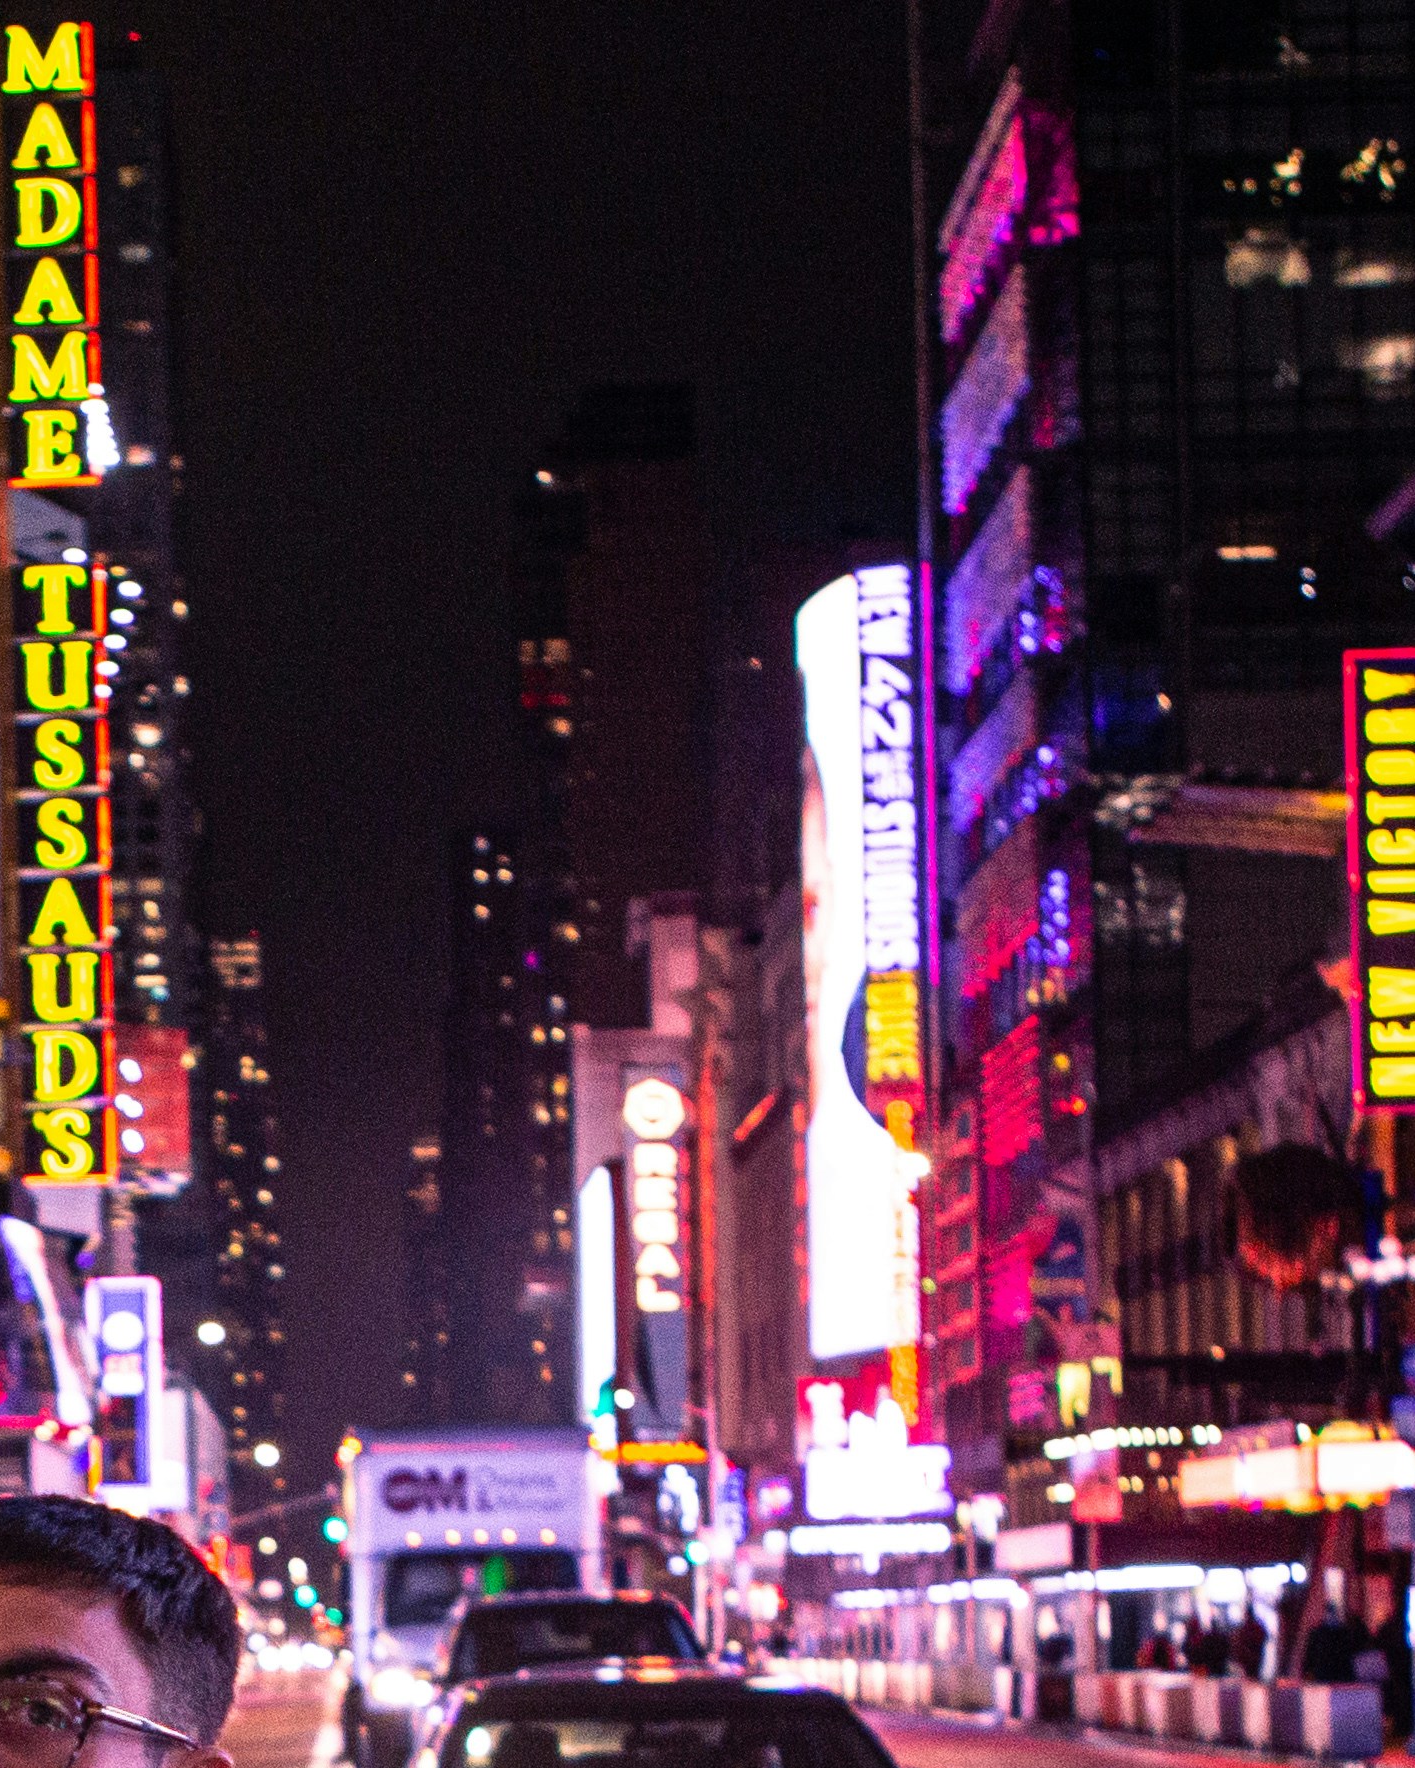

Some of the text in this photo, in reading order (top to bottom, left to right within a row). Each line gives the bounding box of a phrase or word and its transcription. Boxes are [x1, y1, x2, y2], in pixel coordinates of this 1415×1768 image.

[1, 21, 99, 1178] MADAME TUSSAUDS
[854, 563, 913, 656] NEW
[864, 800, 920, 971] STUDIOS
[1363, 668, 1415, 1099] NEW VICTORY
